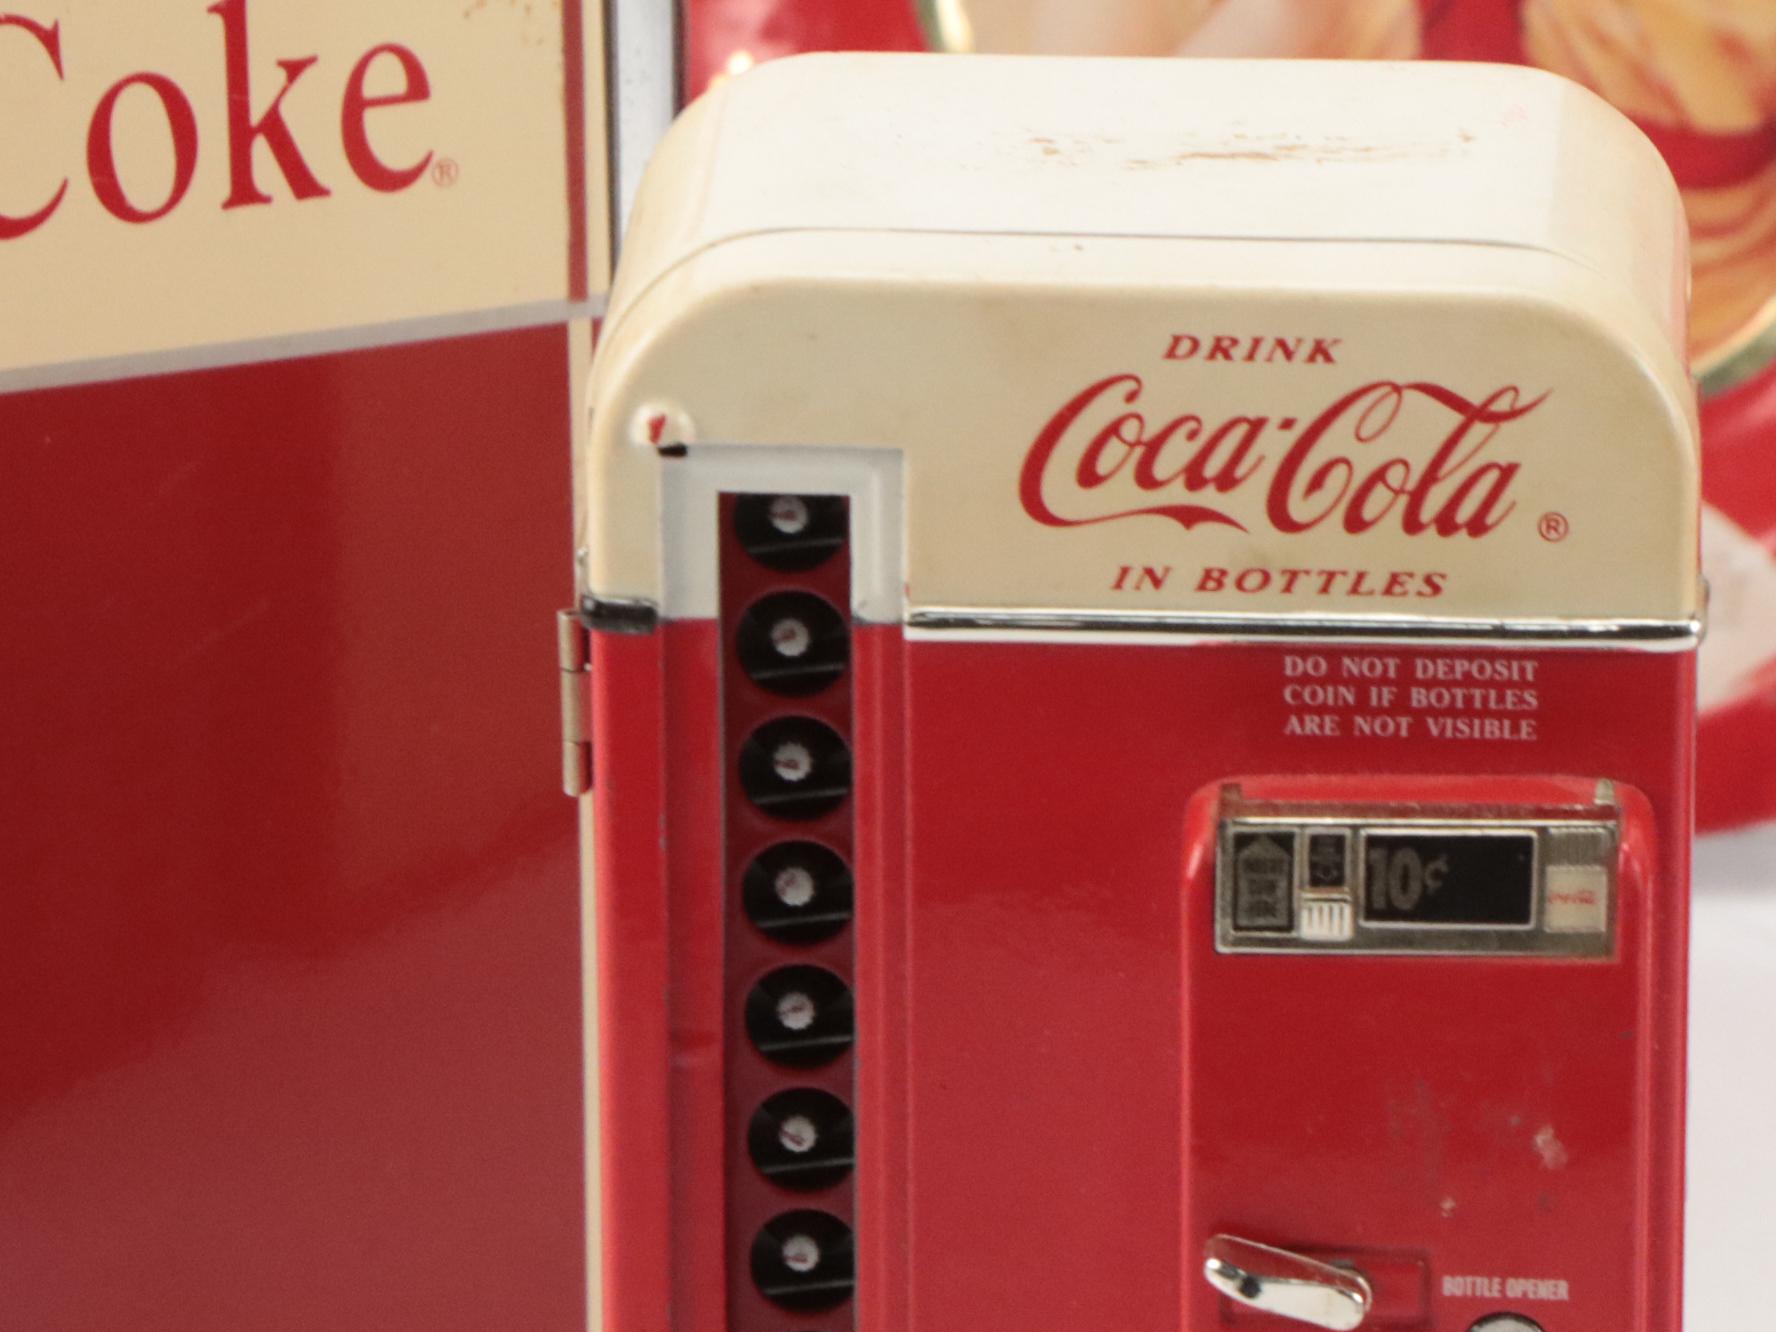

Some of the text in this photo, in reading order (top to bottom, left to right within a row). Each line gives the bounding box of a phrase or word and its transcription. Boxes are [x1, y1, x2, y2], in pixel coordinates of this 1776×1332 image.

[1162, 334, 1342, 365] DRINK
[1111, 564, 1448, 599] IN BOTTLES
[1283, 655, 1538, 682] DO NOT DEPOSIT
[1283, 684, 1538, 710] COIN IF BOTTLES
[1284, 714, 1537, 741] ARE NOT VISIBLE
[1442, 1276, 1569, 1300] BOTTLE OPENER
